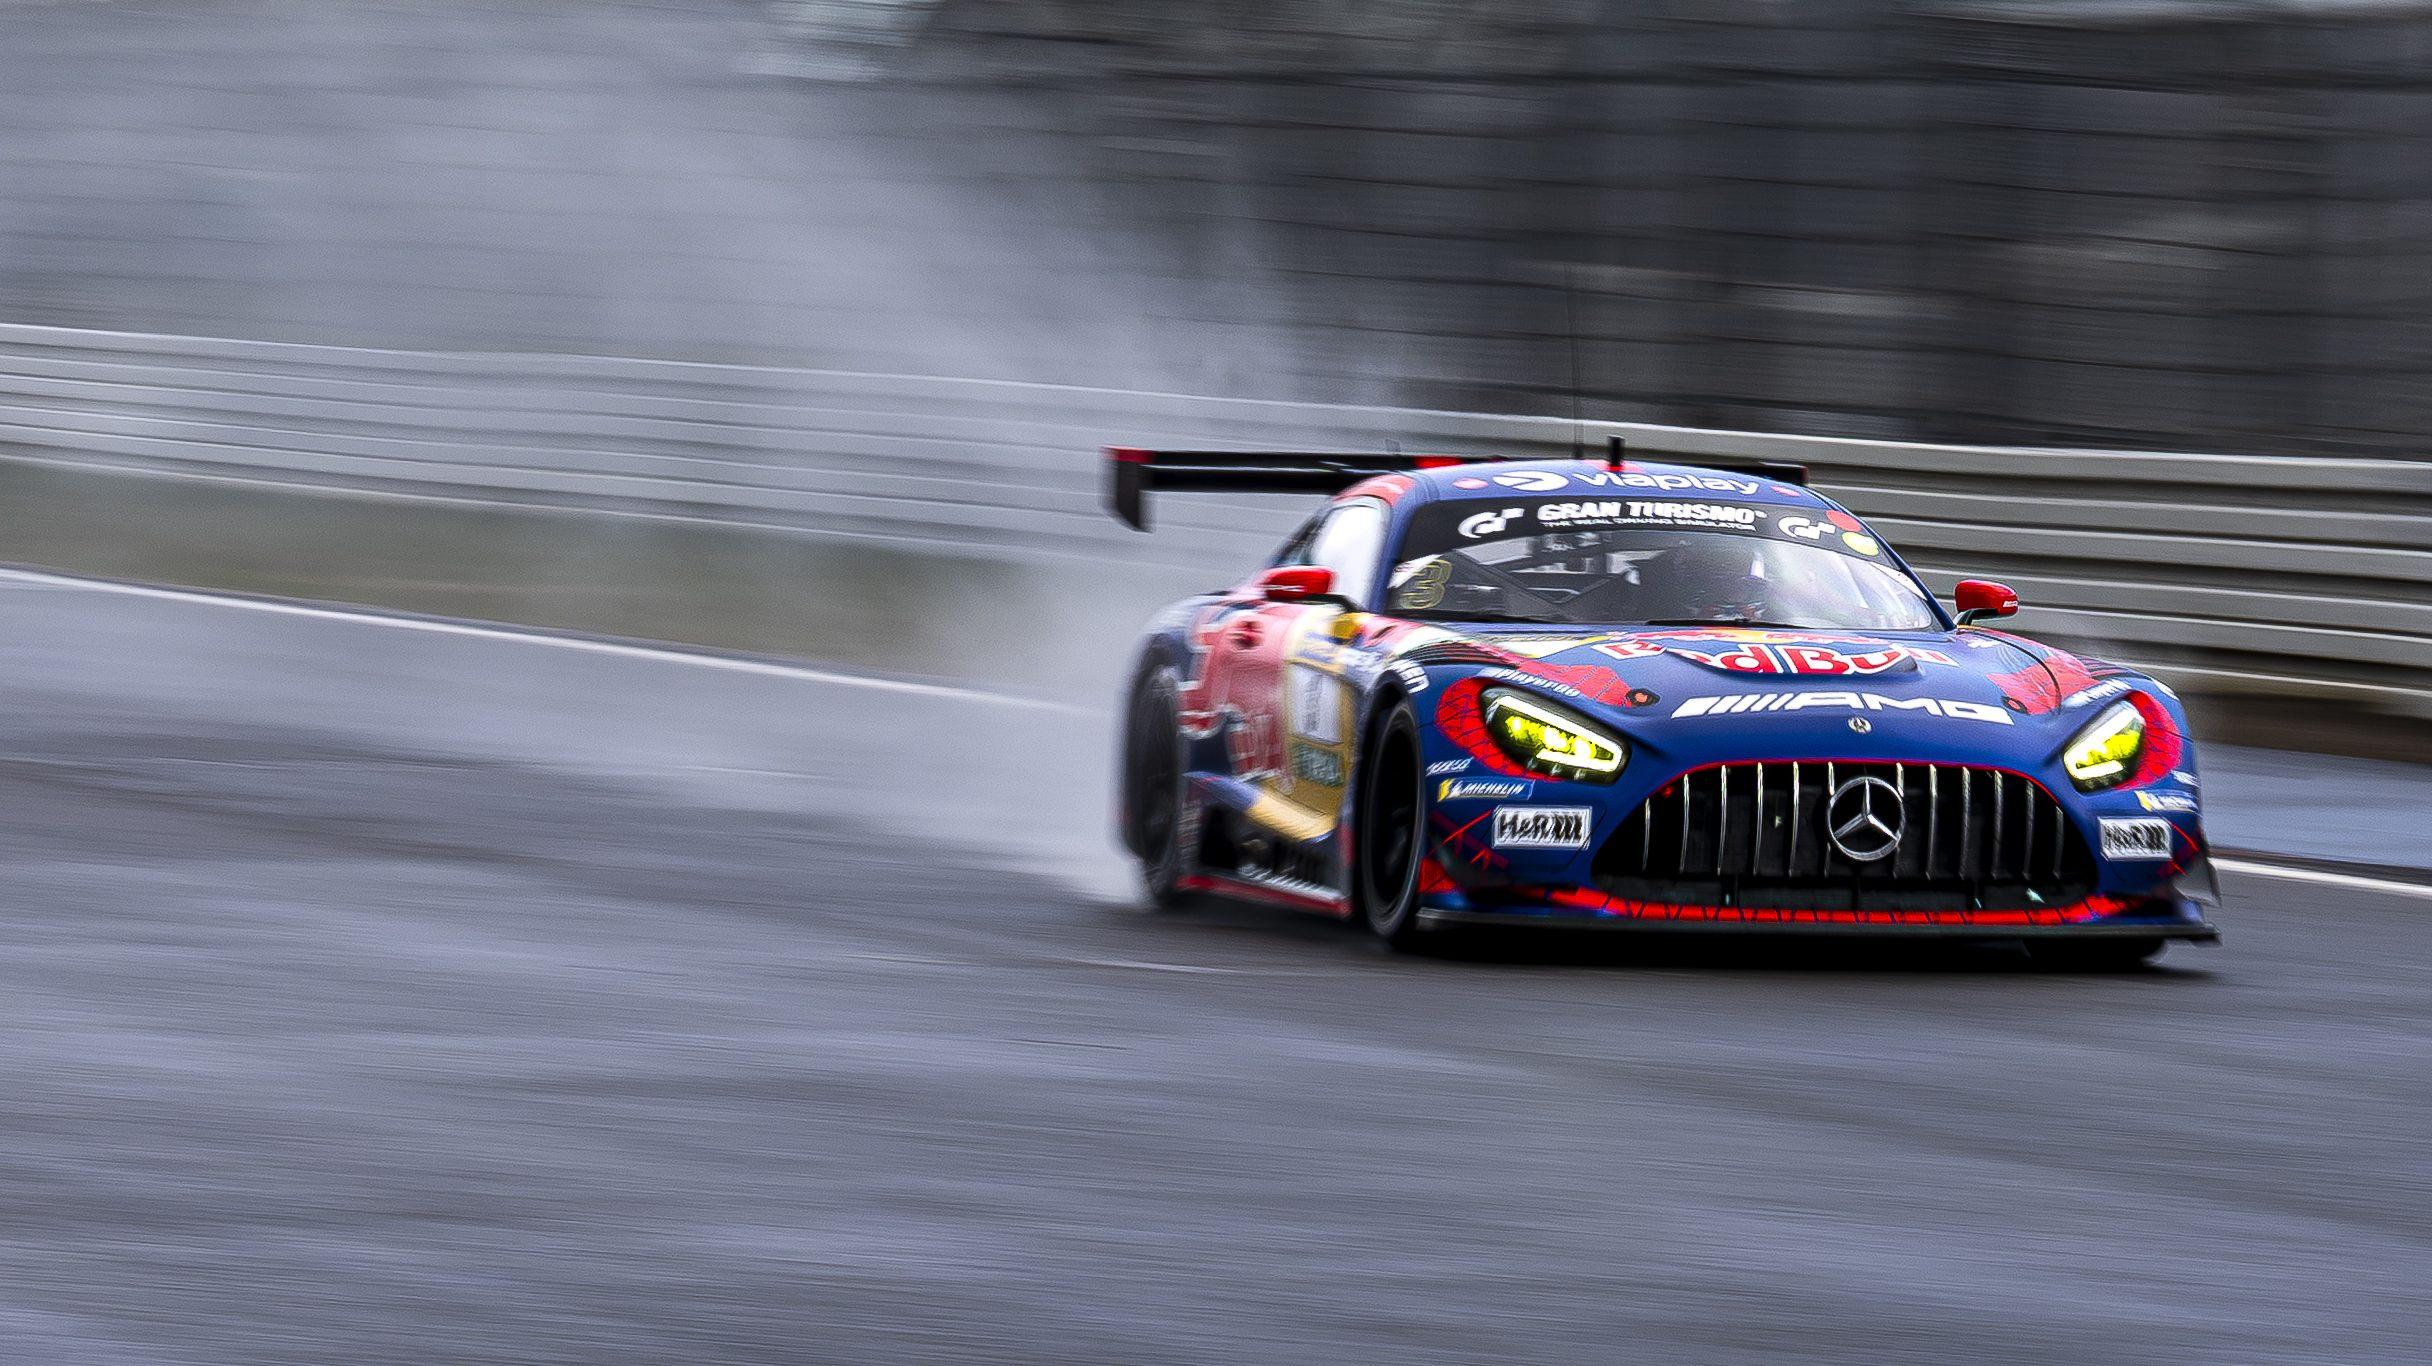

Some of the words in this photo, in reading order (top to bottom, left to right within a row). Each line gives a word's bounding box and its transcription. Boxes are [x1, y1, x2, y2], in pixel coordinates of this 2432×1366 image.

[1572, 472, 1759, 495] viaplay
[1537, 502, 1622, 520] GRAN
[1627, 502, 1755, 524] TURISMO
[1784, 691, 2014, 725] AMG
